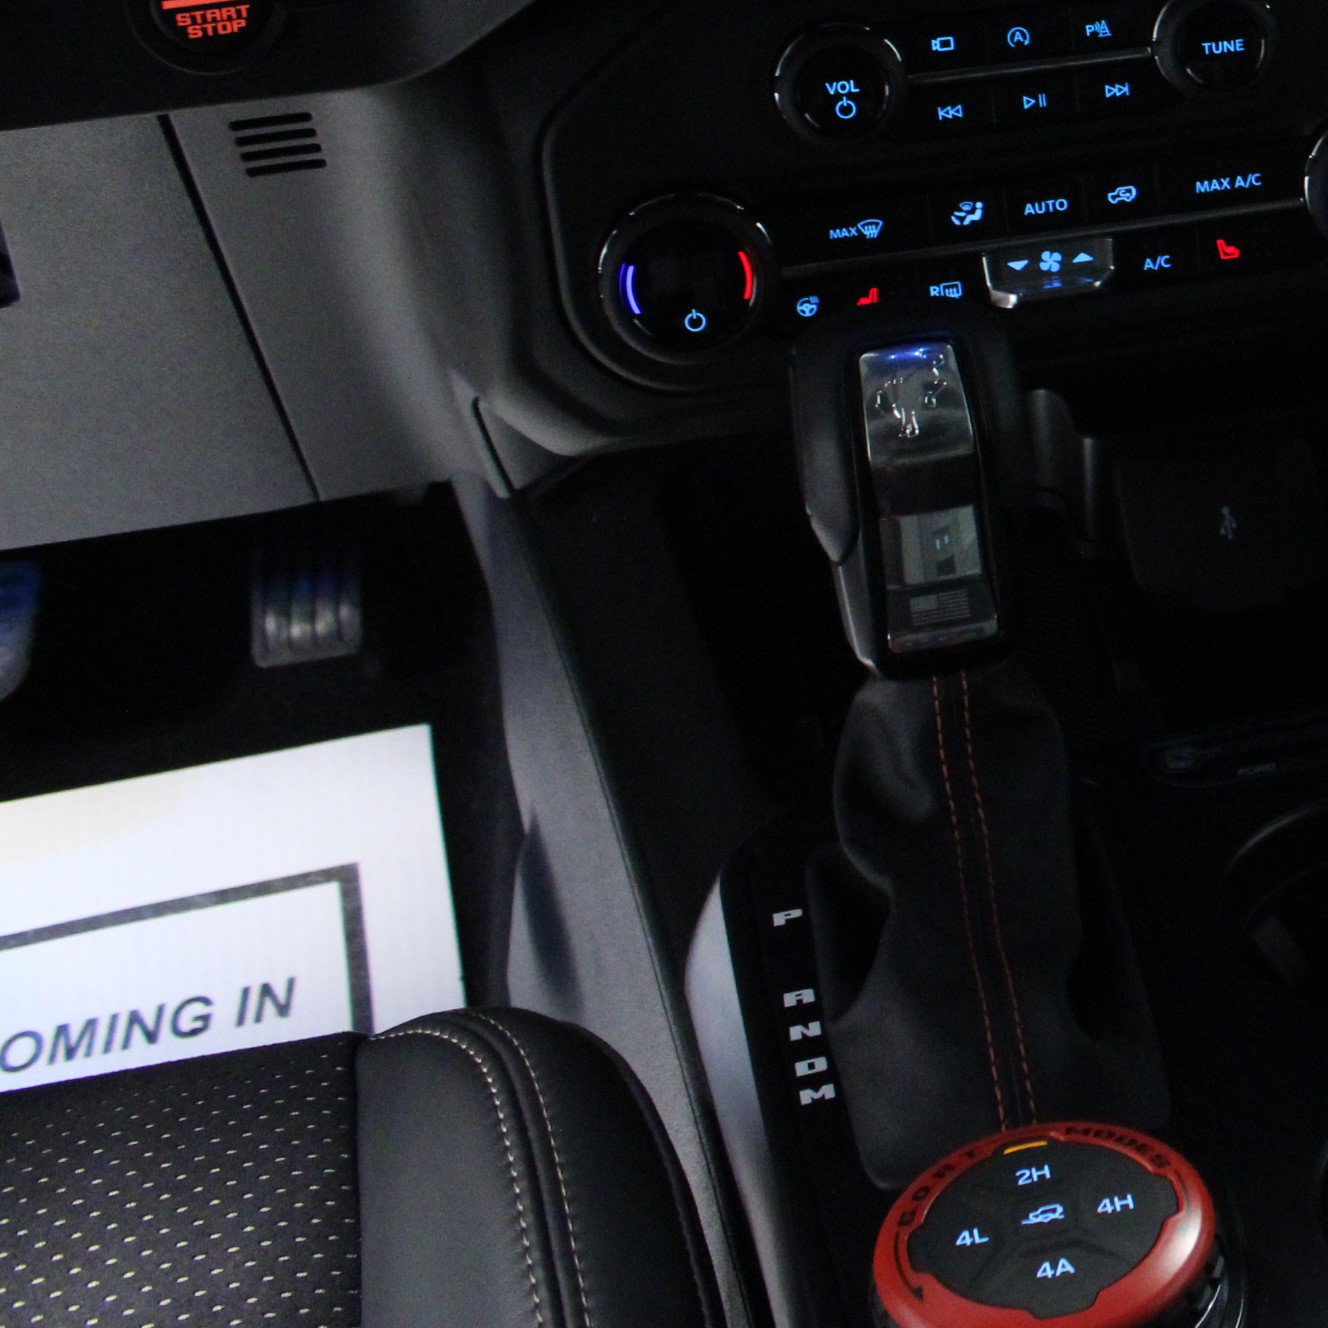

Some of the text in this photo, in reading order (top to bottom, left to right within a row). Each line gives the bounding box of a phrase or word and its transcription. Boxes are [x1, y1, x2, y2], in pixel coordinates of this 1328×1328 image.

[175, 4, 250, 27] START
[187, 19, 247, 39] STOP
[1201, 38, 1245, 55] TUNE
[825, 80, 861, 96] VOL
[1195, 173, 1262, 194] MAX A/C
[1024, 198, 1069, 216] AUTO
[829, 226, 858, 240] MAX
[1143, 255, 1172, 271] A/C
[772, 908, 803, 927] P
[0, 976, 297, 1074] OMING IN
[789, 1020, 822, 1042] N
[799, 1083, 836, 1106] M
[1015, 1164, 1051, 1186] 2H
[1096, 1193, 1135, 1215] 4H
[955, 1227, 989, 1247] 4L
[1036, 1257, 1076, 1280] 4A
